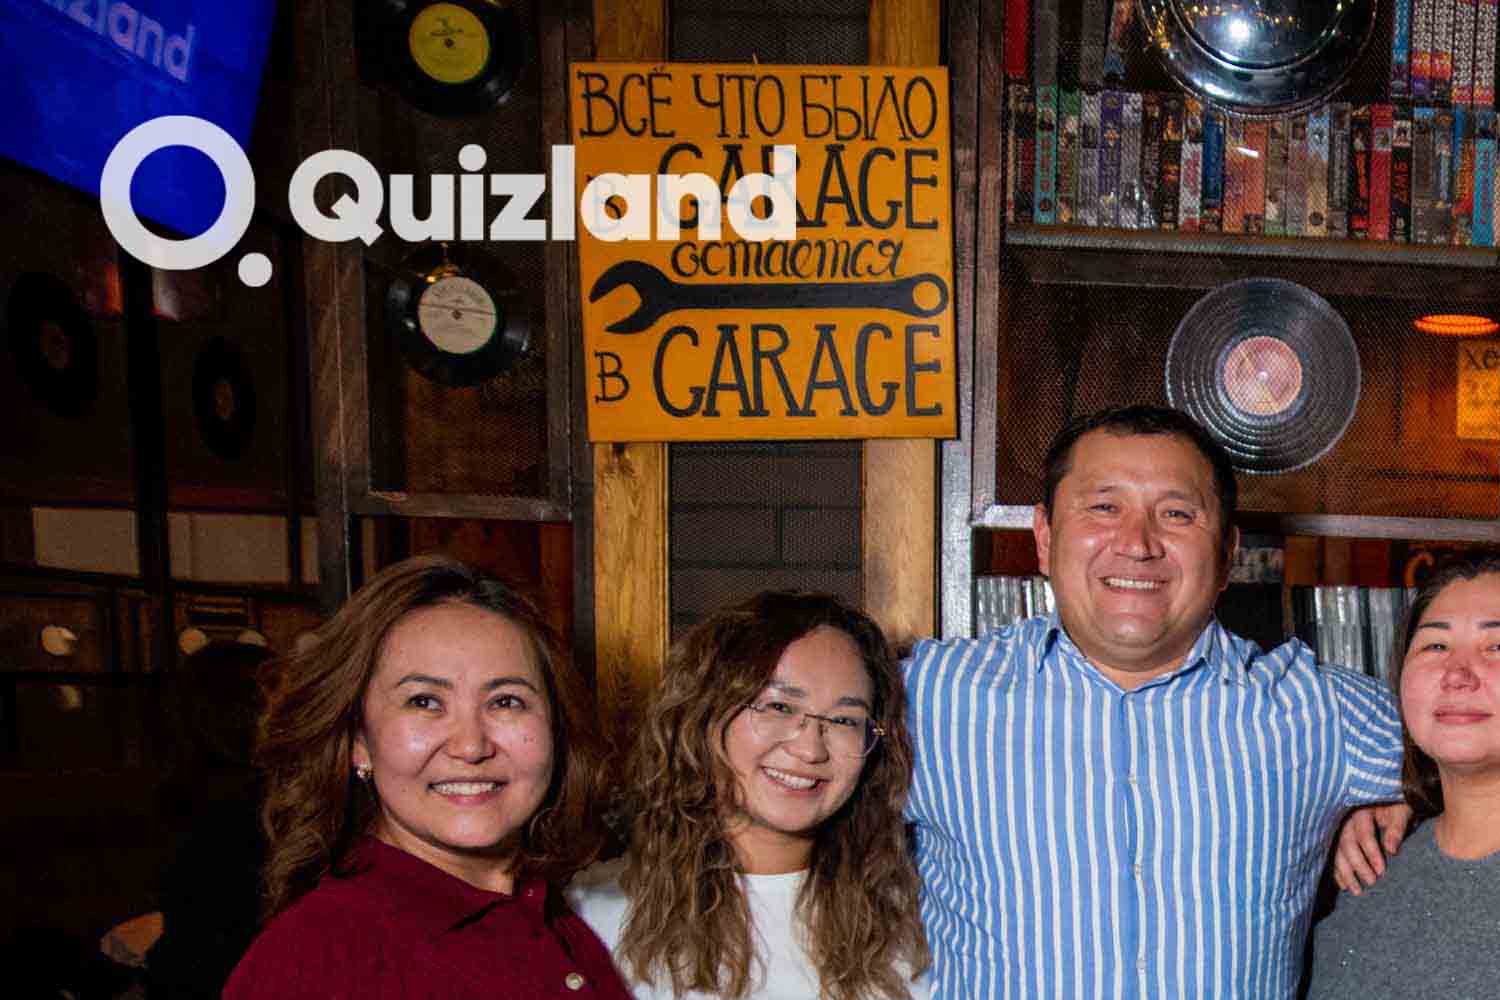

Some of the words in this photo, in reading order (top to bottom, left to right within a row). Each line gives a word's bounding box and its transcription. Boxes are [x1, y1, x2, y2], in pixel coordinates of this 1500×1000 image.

[577, 66, 676, 138] ВСЁ
[693, 74, 785, 139] ЧТО
[801, 74, 938, 141] БЫЛО
[595, 350, 629, 403] В
[652, 323, 943, 418] GARAGE
